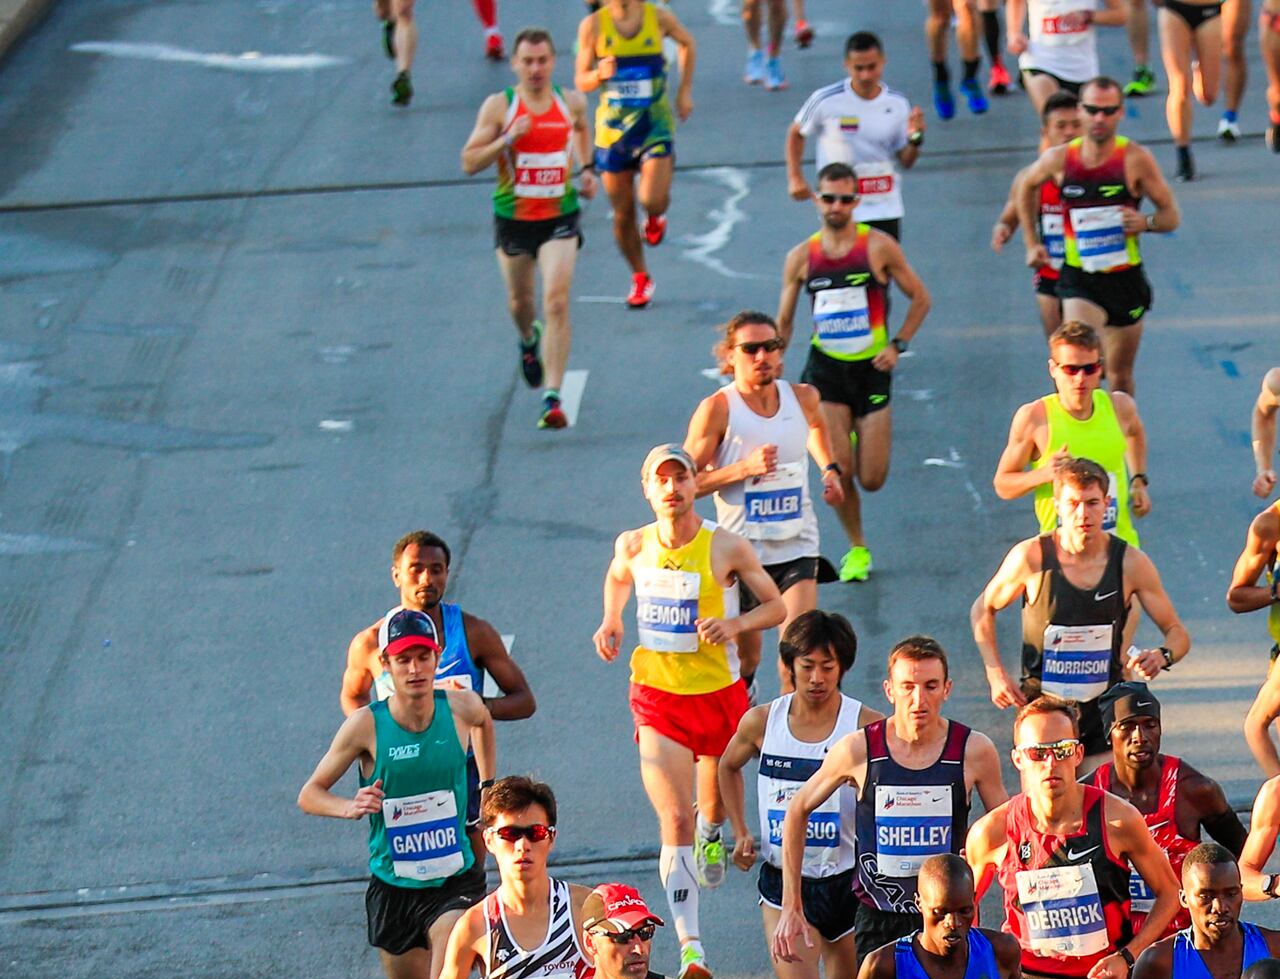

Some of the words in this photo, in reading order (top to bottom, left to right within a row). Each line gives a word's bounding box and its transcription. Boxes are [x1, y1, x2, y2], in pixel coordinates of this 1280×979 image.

[751, 496, 798, 516] FULLER
[643, 604, 691, 625] LEMON
[1045, 659, 1108, 675] MORRISON
[770, 818, 836, 840] MSUO
[878, 825, 949, 847] SHELLEY
[393, 826, 457, 854] GAYNOR
[1029, 904, 1102, 932] DERRICK
[543, 960, 576, 971] TOYOTA
